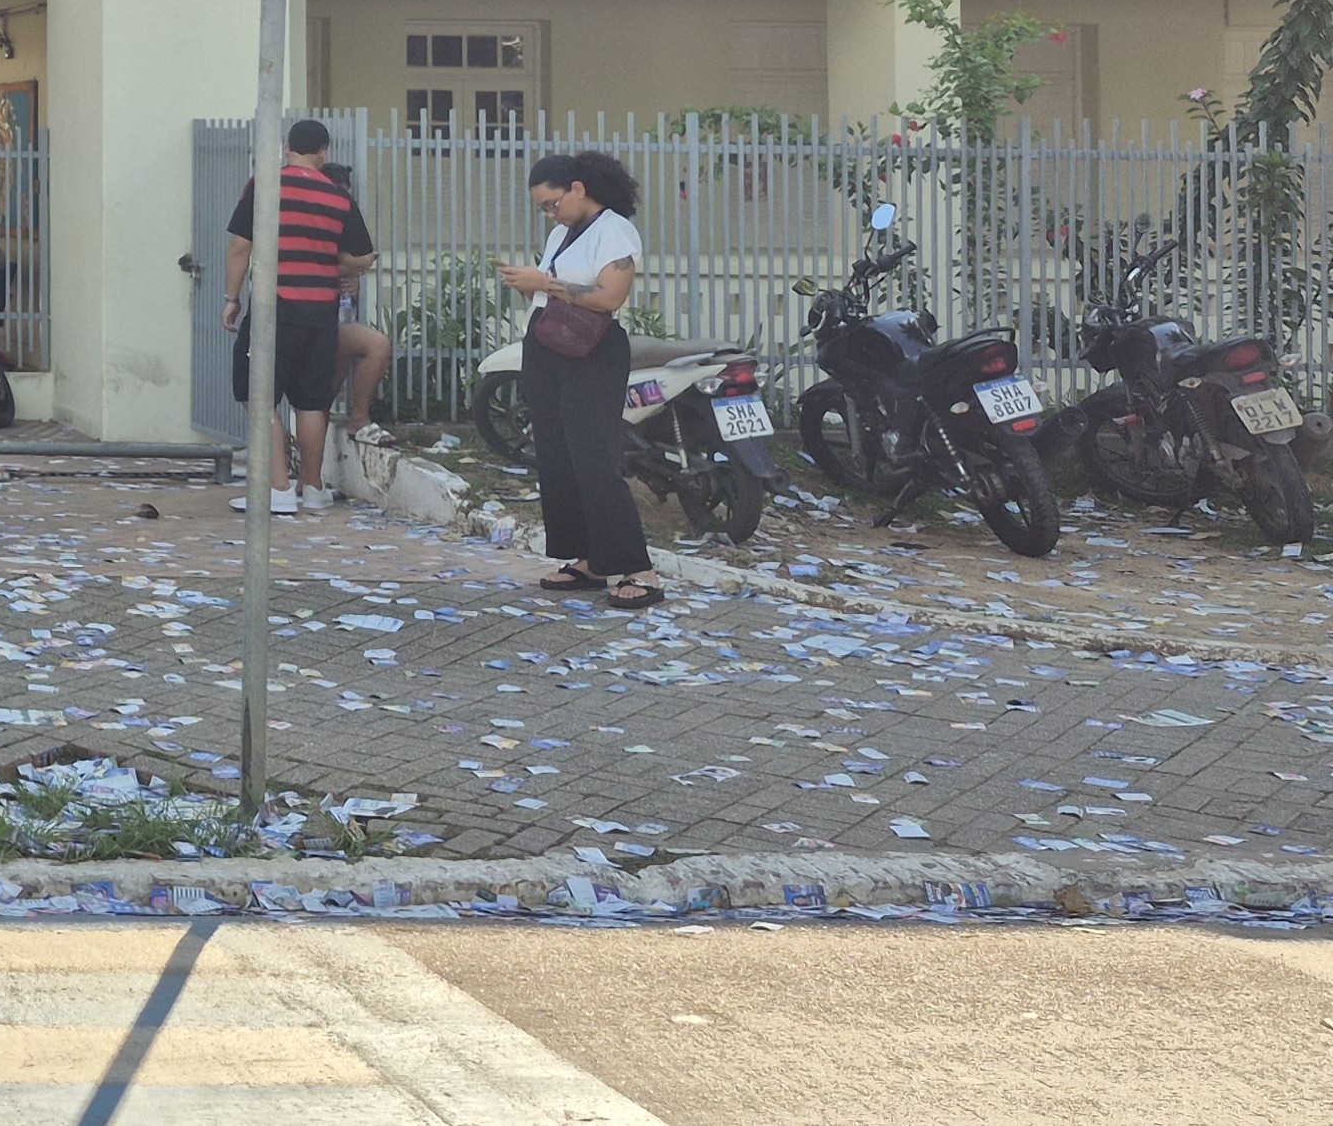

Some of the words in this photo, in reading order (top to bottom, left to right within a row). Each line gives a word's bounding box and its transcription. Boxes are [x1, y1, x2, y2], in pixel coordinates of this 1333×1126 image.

[990, 383, 1024, 403] SHA
[726, 403, 757, 421] SHA
[993, 396, 1031, 418] 8B07
[726, 417, 767, 436] 2G21
[1250, 410, 1293, 431] 2217
